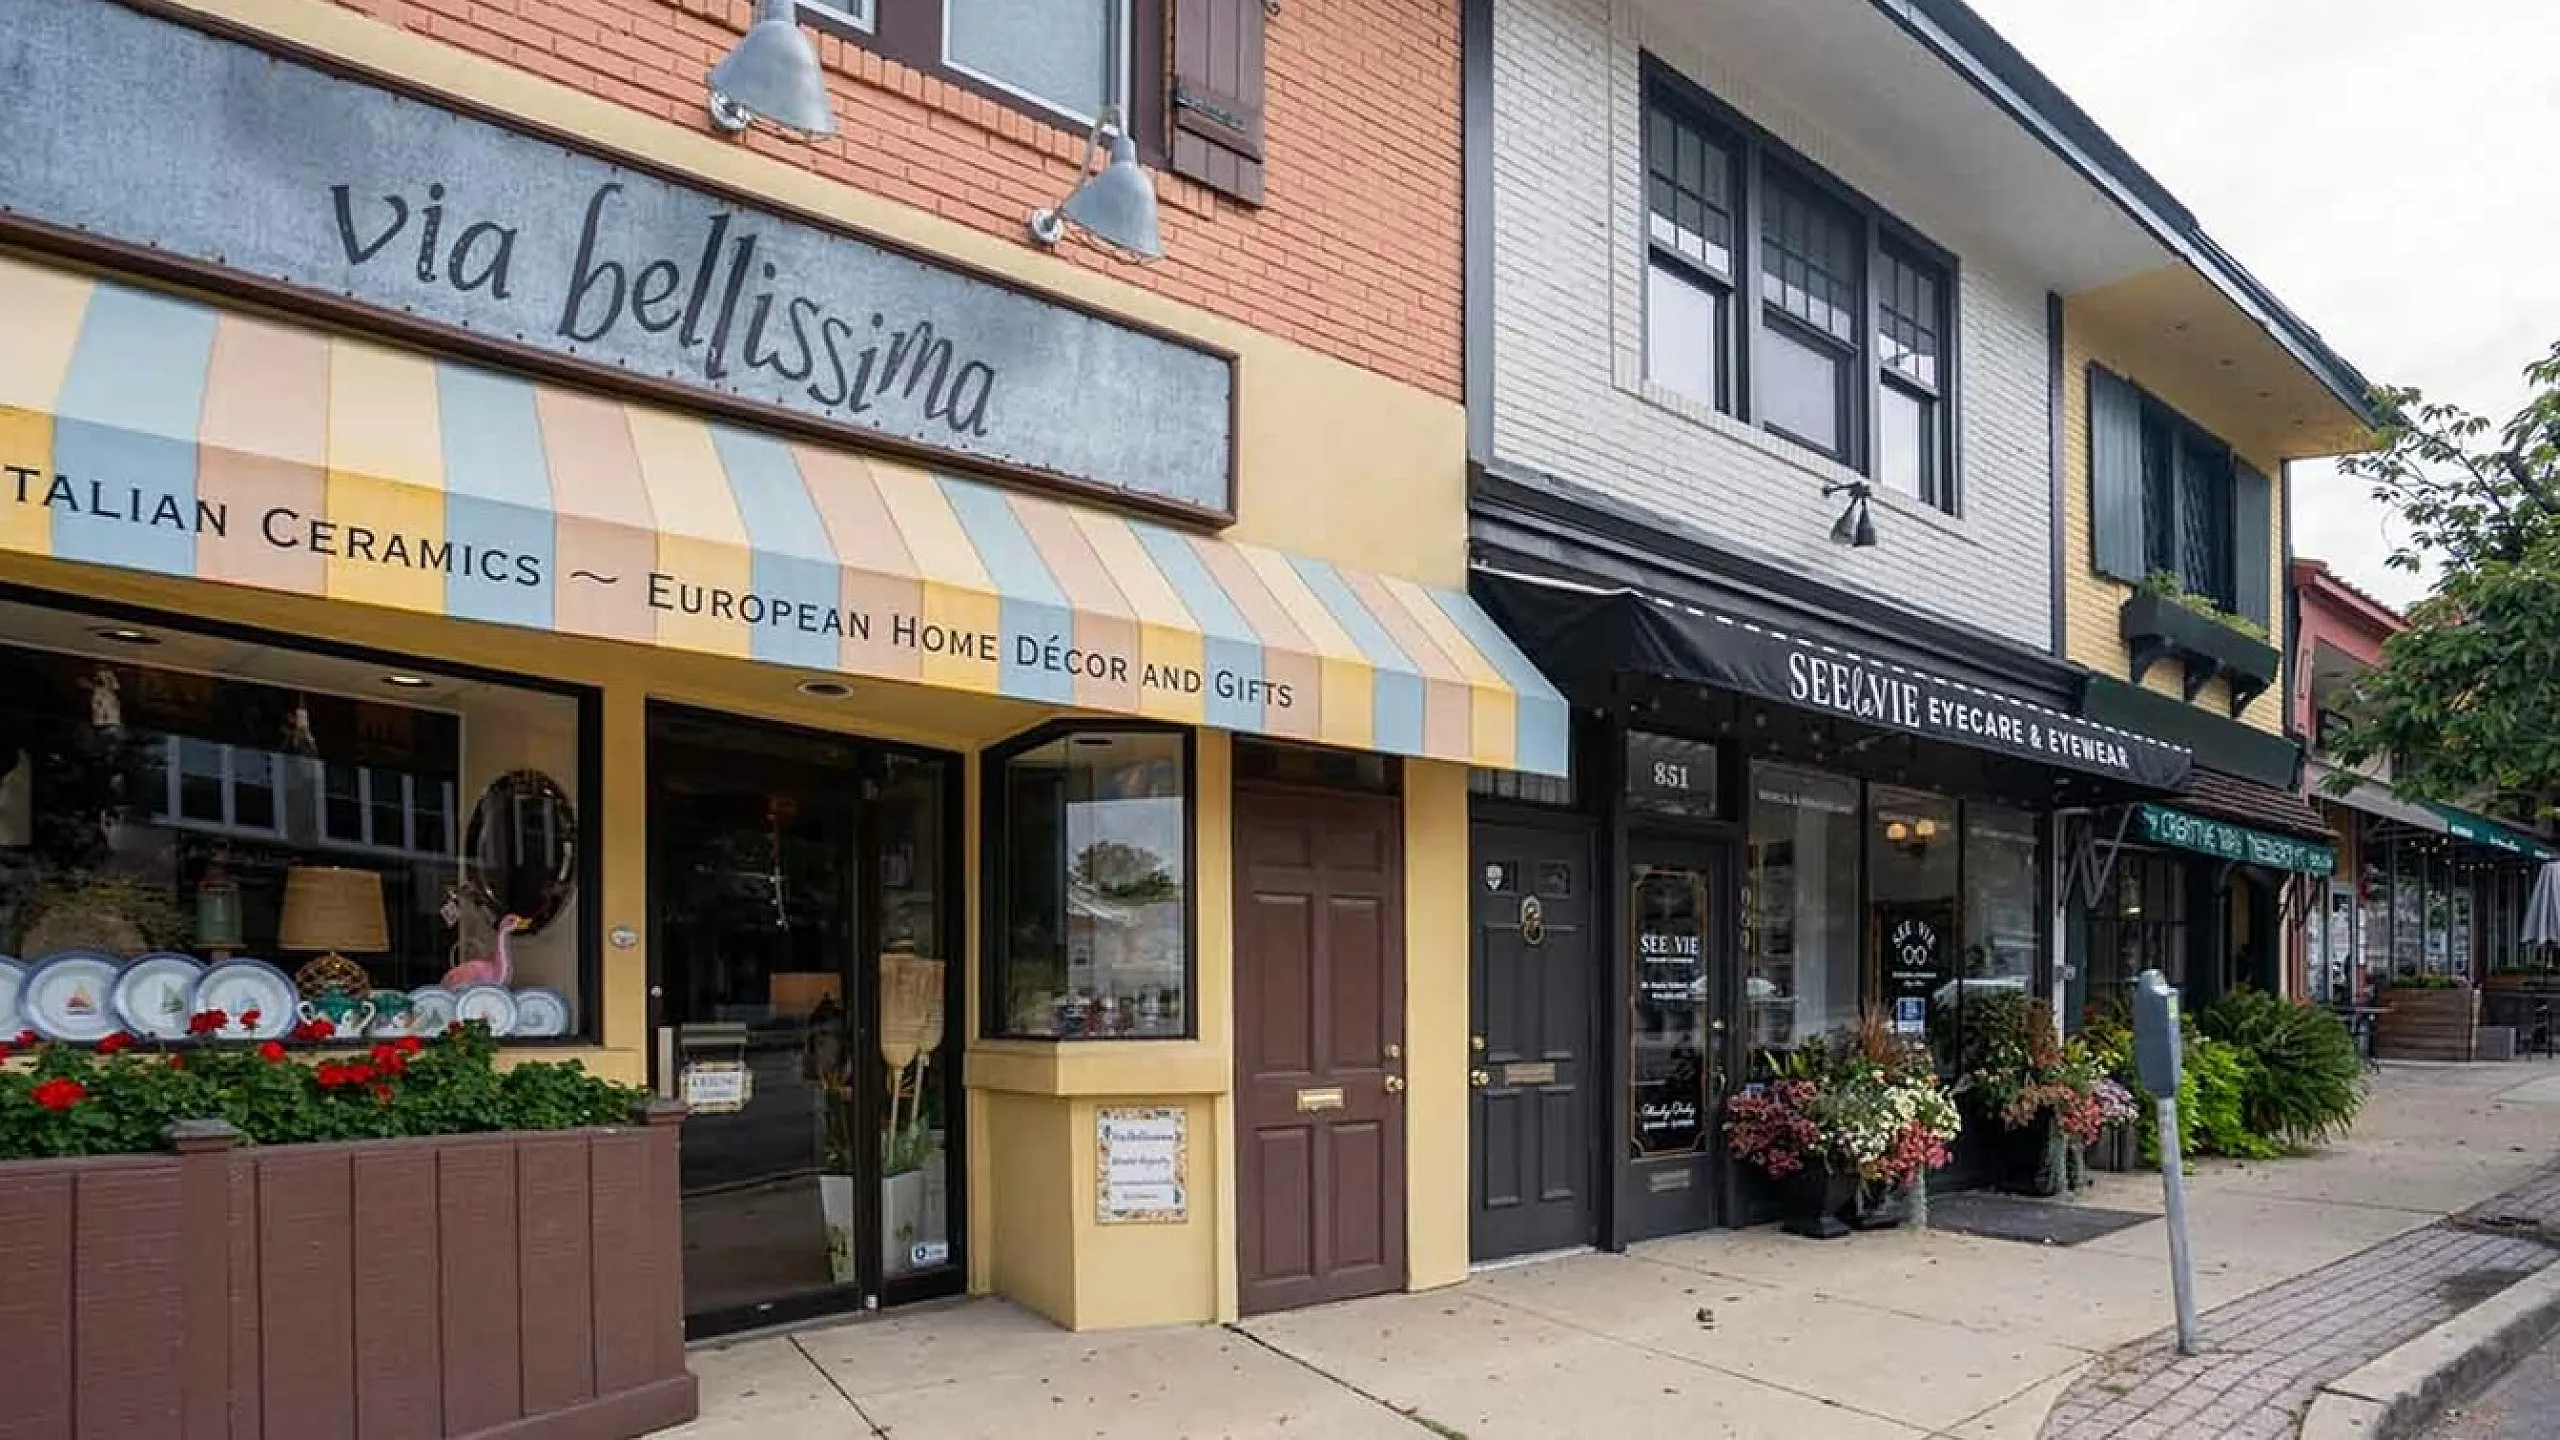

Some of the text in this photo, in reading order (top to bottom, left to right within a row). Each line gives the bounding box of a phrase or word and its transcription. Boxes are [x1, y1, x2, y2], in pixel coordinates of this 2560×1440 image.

[329, 182, 996, 437] via bellissima
[262, 507, 541, 588] CERAMICS
[647, 573, 870, 642] EUROPEAN
[892, 616, 997, 662] HOME
[1016, 633, 1129, 683] DÉCOR
[1142, 664, 1201, 695] AND
[1215, 670, 1293, 709] GIFTS
[1929, 697, 2025, 745] EYECARE
[2030, 724, 2043, 749] &
[2049, 728, 2130, 770] EYEWEAR
[1654, 761, 1690, 790] 851
[1640, 933, 1668, 954] SEE
